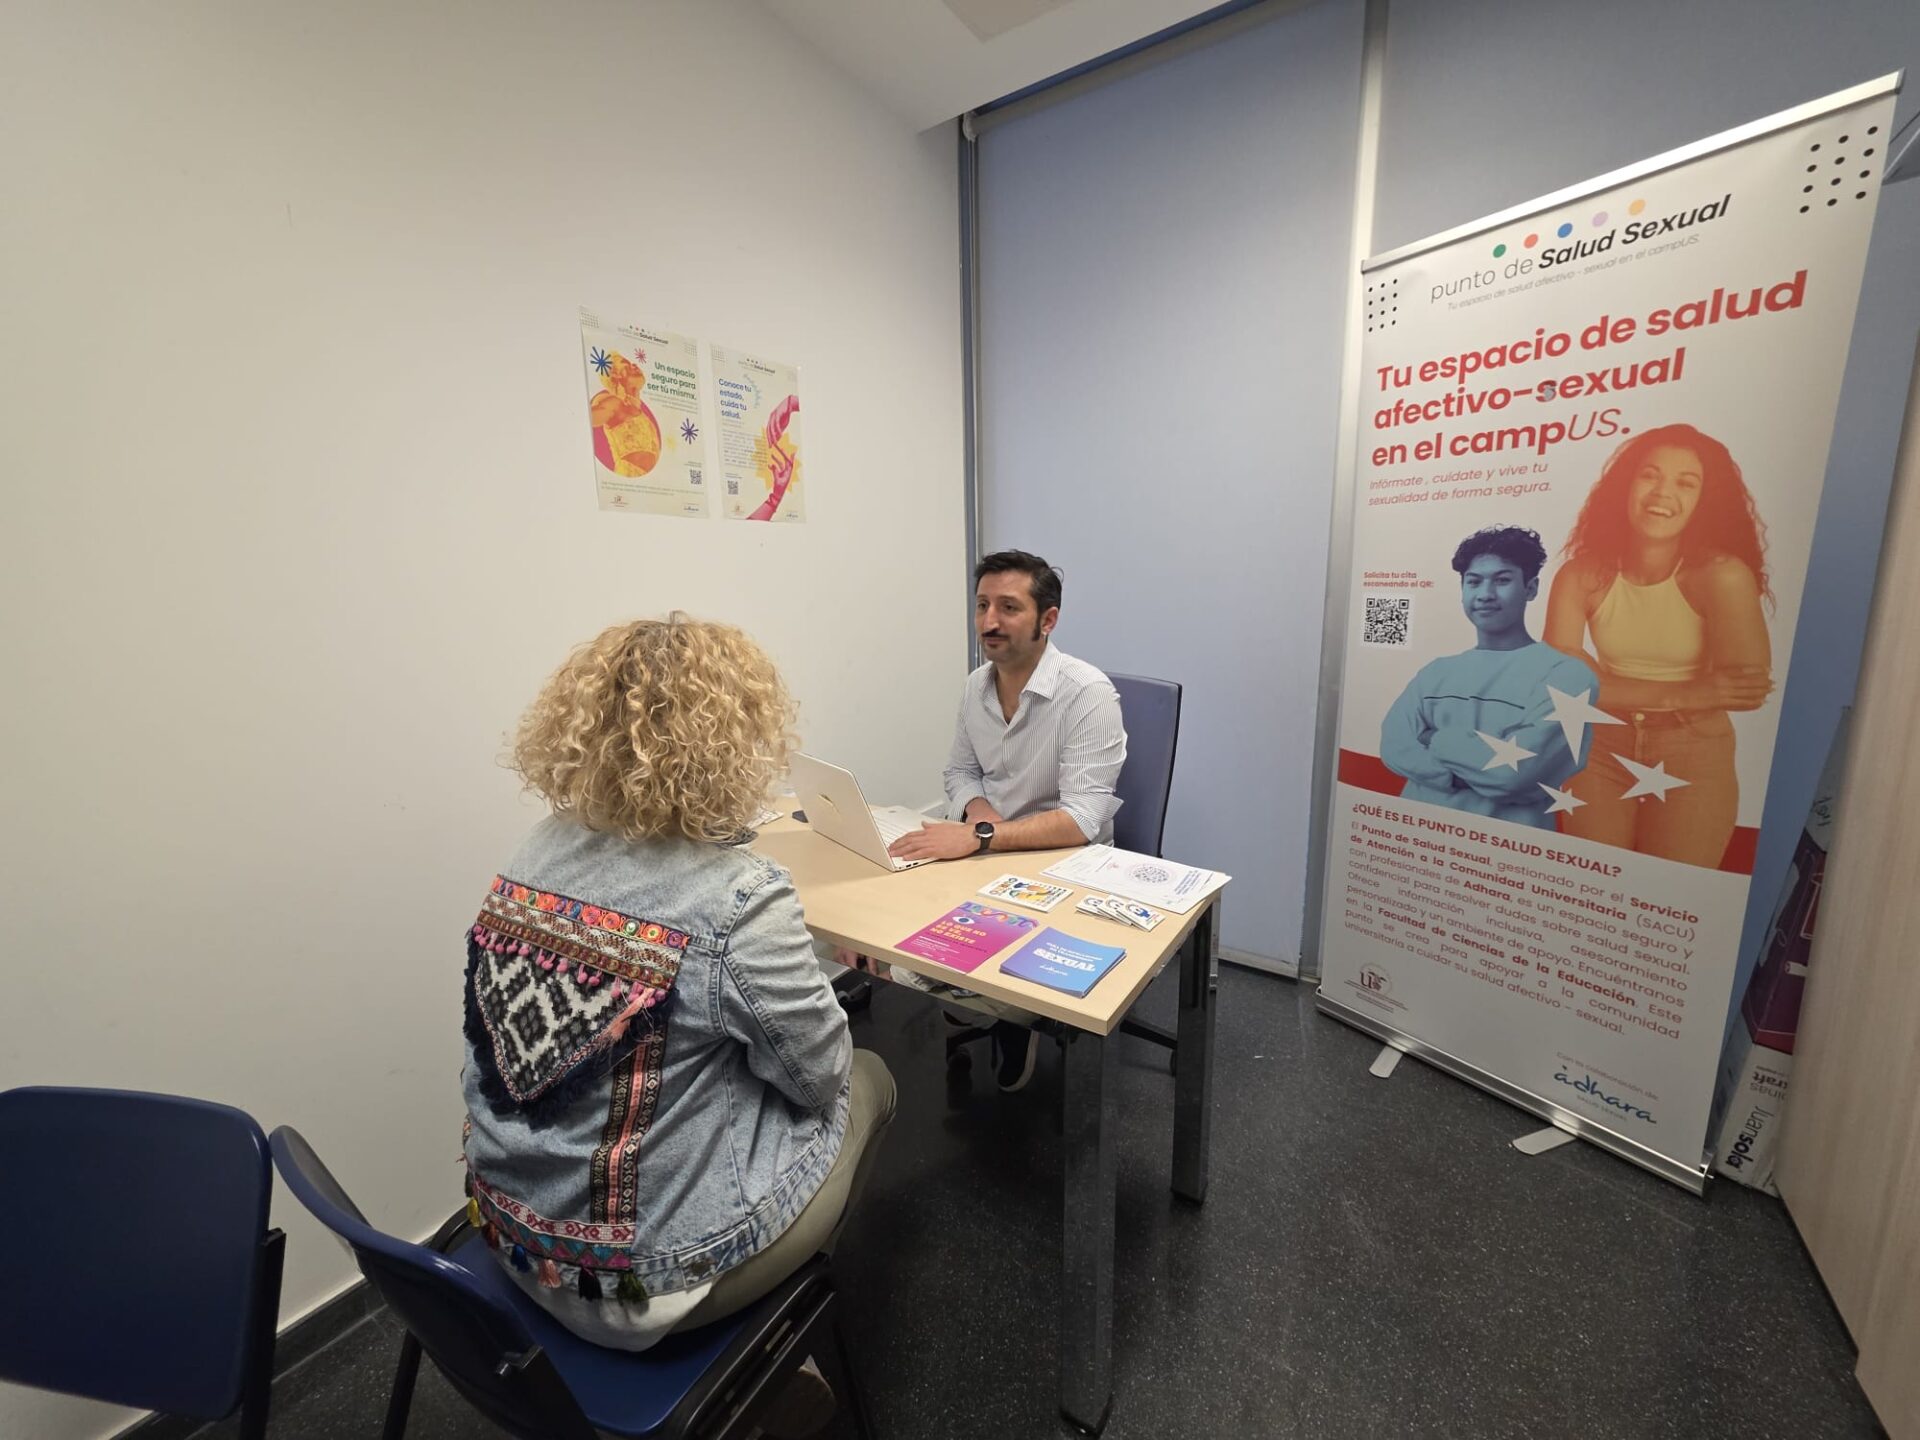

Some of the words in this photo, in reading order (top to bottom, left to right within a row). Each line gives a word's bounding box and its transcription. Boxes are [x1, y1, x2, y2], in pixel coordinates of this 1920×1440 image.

[1430, 268, 1496, 304] punto
[1503, 257, 1534, 281] de
[1538, 229, 1616, 270] Salud
[1621, 193, 1732, 245] Sexual
[1494, 287, 1506, 298] de
[1507, 281, 1534, 296] salud
[1583, 257, 1618, 276] sexual
[1618, 254, 1634, 266] en
[1635, 248, 1647, 261] el
[1376, 364, 1413, 392] Tu
[1418, 327, 1571, 383] espacio
[1580, 305, 1637, 350] de
[1645, 270, 1809, 337] salud
[646, 382, 660, 391] ser
[651, 372, 679, 385] seguro
[679, 380, 696, 390] para
[654, 361, 666, 371] Un
[666, 365, 696, 380] espacio
[718, 378, 744, 391] Conoce
[744, 383, 752, 392] tu
[720, 399, 740, 410] cuida
[740, 402, 747, 411] tu
[1370, 442, 1407, 467] en
[1412, 430, 1443, 461] el
[1448, 408, 1632, 457] campUS.
[1367, 490, 1429, 506] sexualidad
[1431, 489, 1449, 501] de
[1451, 486, 1493, 500] forma
[1496, 481, 1553, 497] segura.
[1486, 468, 1496, 479] y
[1498, 464, 1529, 477] vive
[1532, 462, 1548, 474] tu
[1363, 571, 1390, 579] Solicita
[1391, 571, 1400, 579] tu
[1400, 571, 1417, 579] cita
[1363, 580, 1409, 588] escaneando
[1410, 580, 1418, 588] el
[1352, 803, 1383, 818] ¿QUÉ
[1384, 810, 1400, 822] ES
[1402, 814, 1417, 827] EL
[1418, 818, 1467, 838] PUNTO
[1469, 830, 1488, 845] DE
[1490, 836, 1543, 857] SALUD
[1545, 849, 1622, 878] SEXUAL?
[1361, 823, 1393, 840] Punto
[1395, 833, 1409, 844] de
[1412, 837, 1446, 853] Salud
[1496, 860, 1575, 889] gestionado
[1580, 883, 1606, 897] por
[1610, 892, 1624, 904] el
[1629, 896, 1700, 925] Servicio
[1348, 859, 1411, 885] confidencial
[1413, 879, 1441, 895] para
[1444, 887, 1492, 910] resolver
[1494, 904, 1538, 925] dudas
[1541, 918, 1582, 939] sobre
[1586, 933, 1630, 955] salud
[1633, 949, 1692, 976] sexual.
[1349, 847, 1367, 860] con
[1369, 851, 1442, 881] profesionales
[1444, 874, 1461, 886] de
[1517, 896, 1533, 908] es
[1536, 903, 1555, 915] un
[1558, 909, 1618, 935] espacio
[1621, 928, 1678, 954] seguro
[1682, 948, 1695, 962] y
[1350, 834, 1363, 845] de
[1366, 839, 1415, 860] Atención
[1419, 854, 1428, 864] a
[1432, 856, 1445, 867] la
[1449, 861, 1526, 891] Comunidad
[1531, 884, 1628, 921] Universitaria
[1635, 913, 1696, 943] (SACU)
[1033, 947, 1097, 972] SEXUAL
[1345, 895, 1358, 908] en
[1362, 902, 1373, 913] la
[1377, 906, 1427, 931] Facultad
[1431, 925, 1447, 938] de
[1451, 933, 1506, 960] Ciencias
[1512, 953, 1530, 967] de
[1535, 961, 1550, 975] la
[1648, 1003, 1684, 1025] Este
[1346, 884, 1418, 915] personalizado
[1418, 907, 1427, 919] y
[1428, 911, 1444, 923] un
[1446, 916, 1505, 944] ambiente
[1506, 937, 1525, 950] de
[1527, 942, 1575, 970] apoyo.
[1577, 960, 1686, 1009] Encuéntranos
[1347, 871, 1381, 889] Ofrece
[1397, 888, 1466, 917] información
[1569, 943, 1689, 992] asesoramiento
[1343, 919, 1406, 951] universitaria
[1405, 943, 1415, 953] a
[1415, 946, 1453, 967] cuidar
[1453, 961, 1469, 974] su
[1470, 966, 1505, 988] salud
[1506, 979, 1562, 1009] afectivo
[1575, 1006, 1626, 1036] sexual.
[1344, 908, 1374, 926] punto
[1382, 921, 1396, 933] se
[1404, 929, 1430, 945] crea
[1439, 942, 1469, 960] para
[1478, 956, 1526, 981] apoyar
[1537, 979, 1548, 989] a
[1560, 985, 1575, 999] la
[1588, 998, 1681, 1040] comunidad
[1725, 1104, 1775, 1171] Juansola
